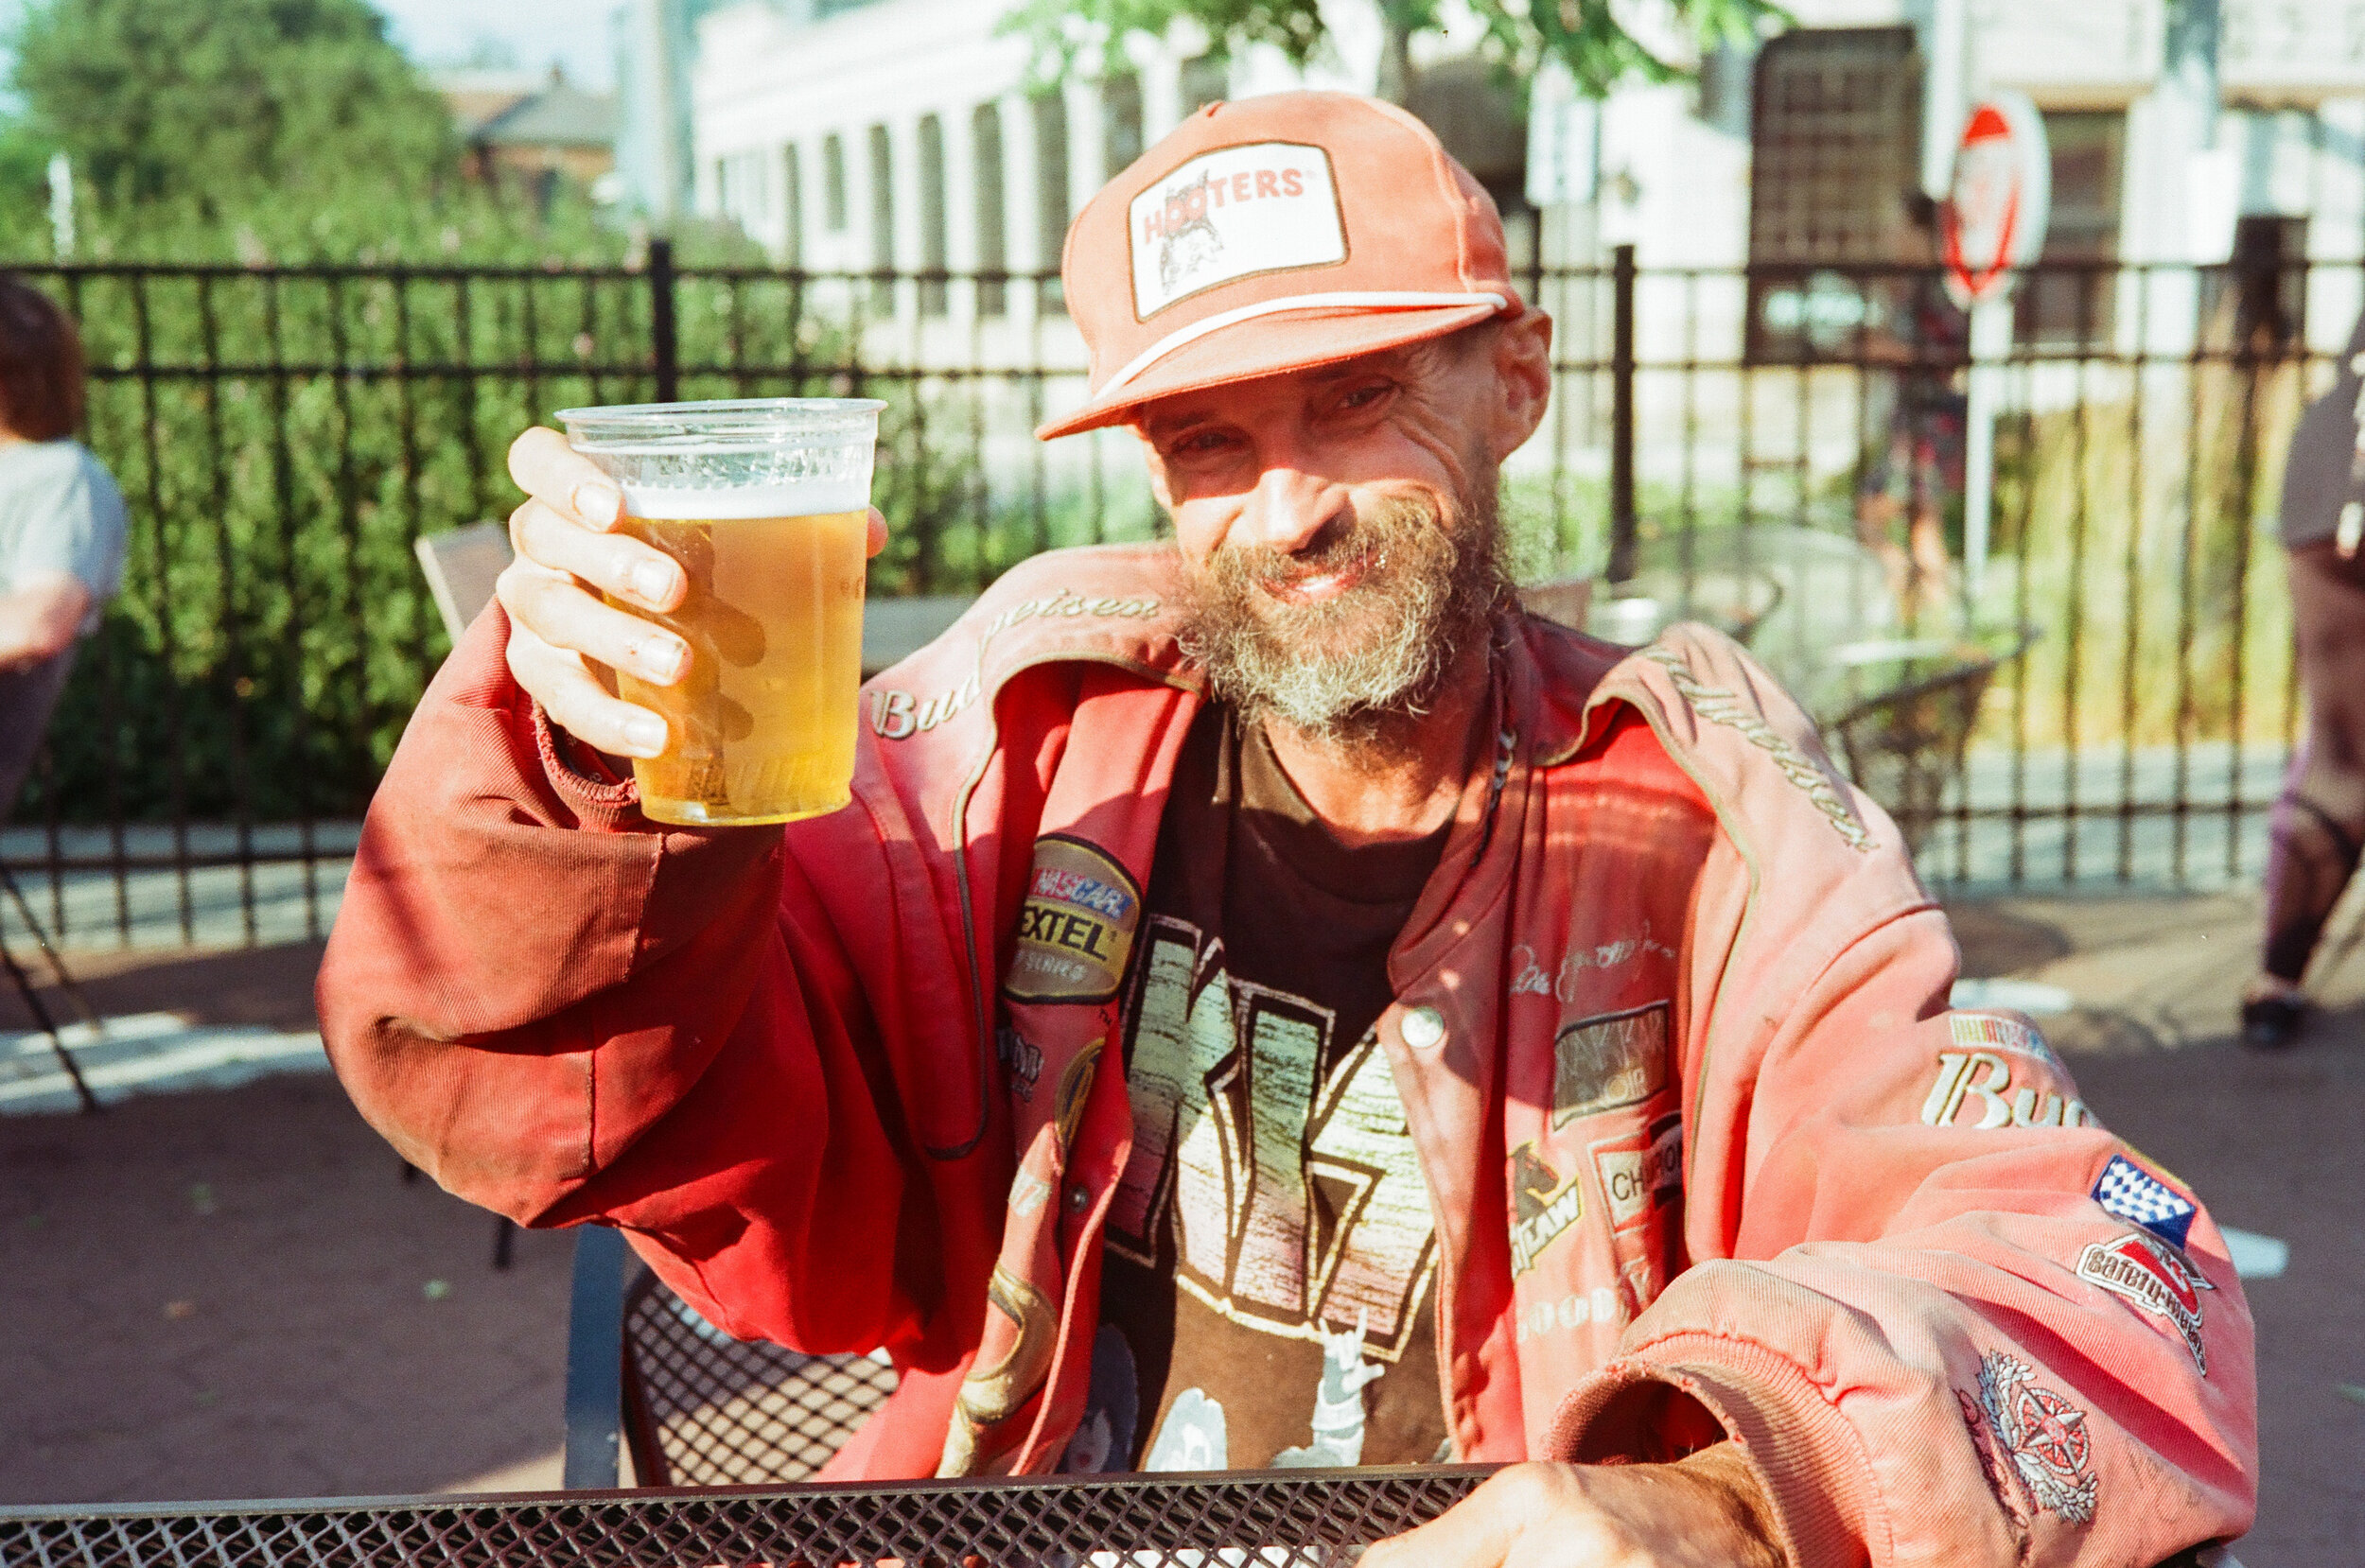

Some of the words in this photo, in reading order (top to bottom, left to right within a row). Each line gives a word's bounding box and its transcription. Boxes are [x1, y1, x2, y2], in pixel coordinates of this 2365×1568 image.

[1143, 168, 1305, 245] HOOTERS
[1021, 905, 1108, 962] EXTEL
[1105, 914, 1444, 1364] KIS
